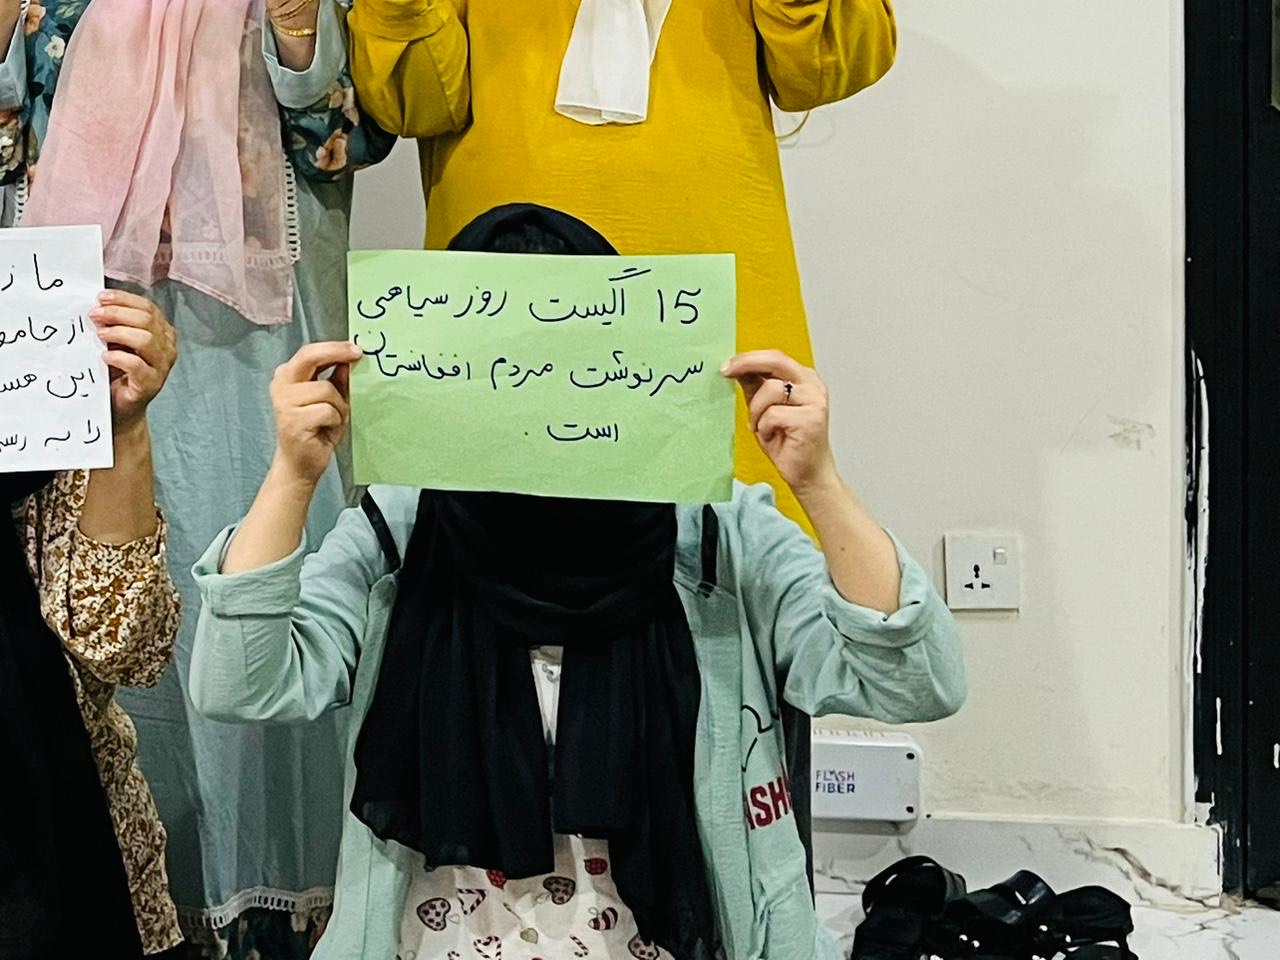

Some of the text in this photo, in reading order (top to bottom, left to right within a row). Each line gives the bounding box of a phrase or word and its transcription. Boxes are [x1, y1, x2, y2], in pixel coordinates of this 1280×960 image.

[33, 253, 63, 291] ما
[357, 285, 448, 319] سیاهی
[453, 286, 507, 318] روز
[657, 288, 701, 324] 15
[67, 315, 84, 344] از
[354, 331, 704, 397] سرنوشت مردم افغانستان
[47, 368, 95, 399] این
[44, 430, 71, 451] به
[83, 419, 100, 444] را
[815, 769, 856, 783] FLASH
[815, 782, 856, 795] FIBER
